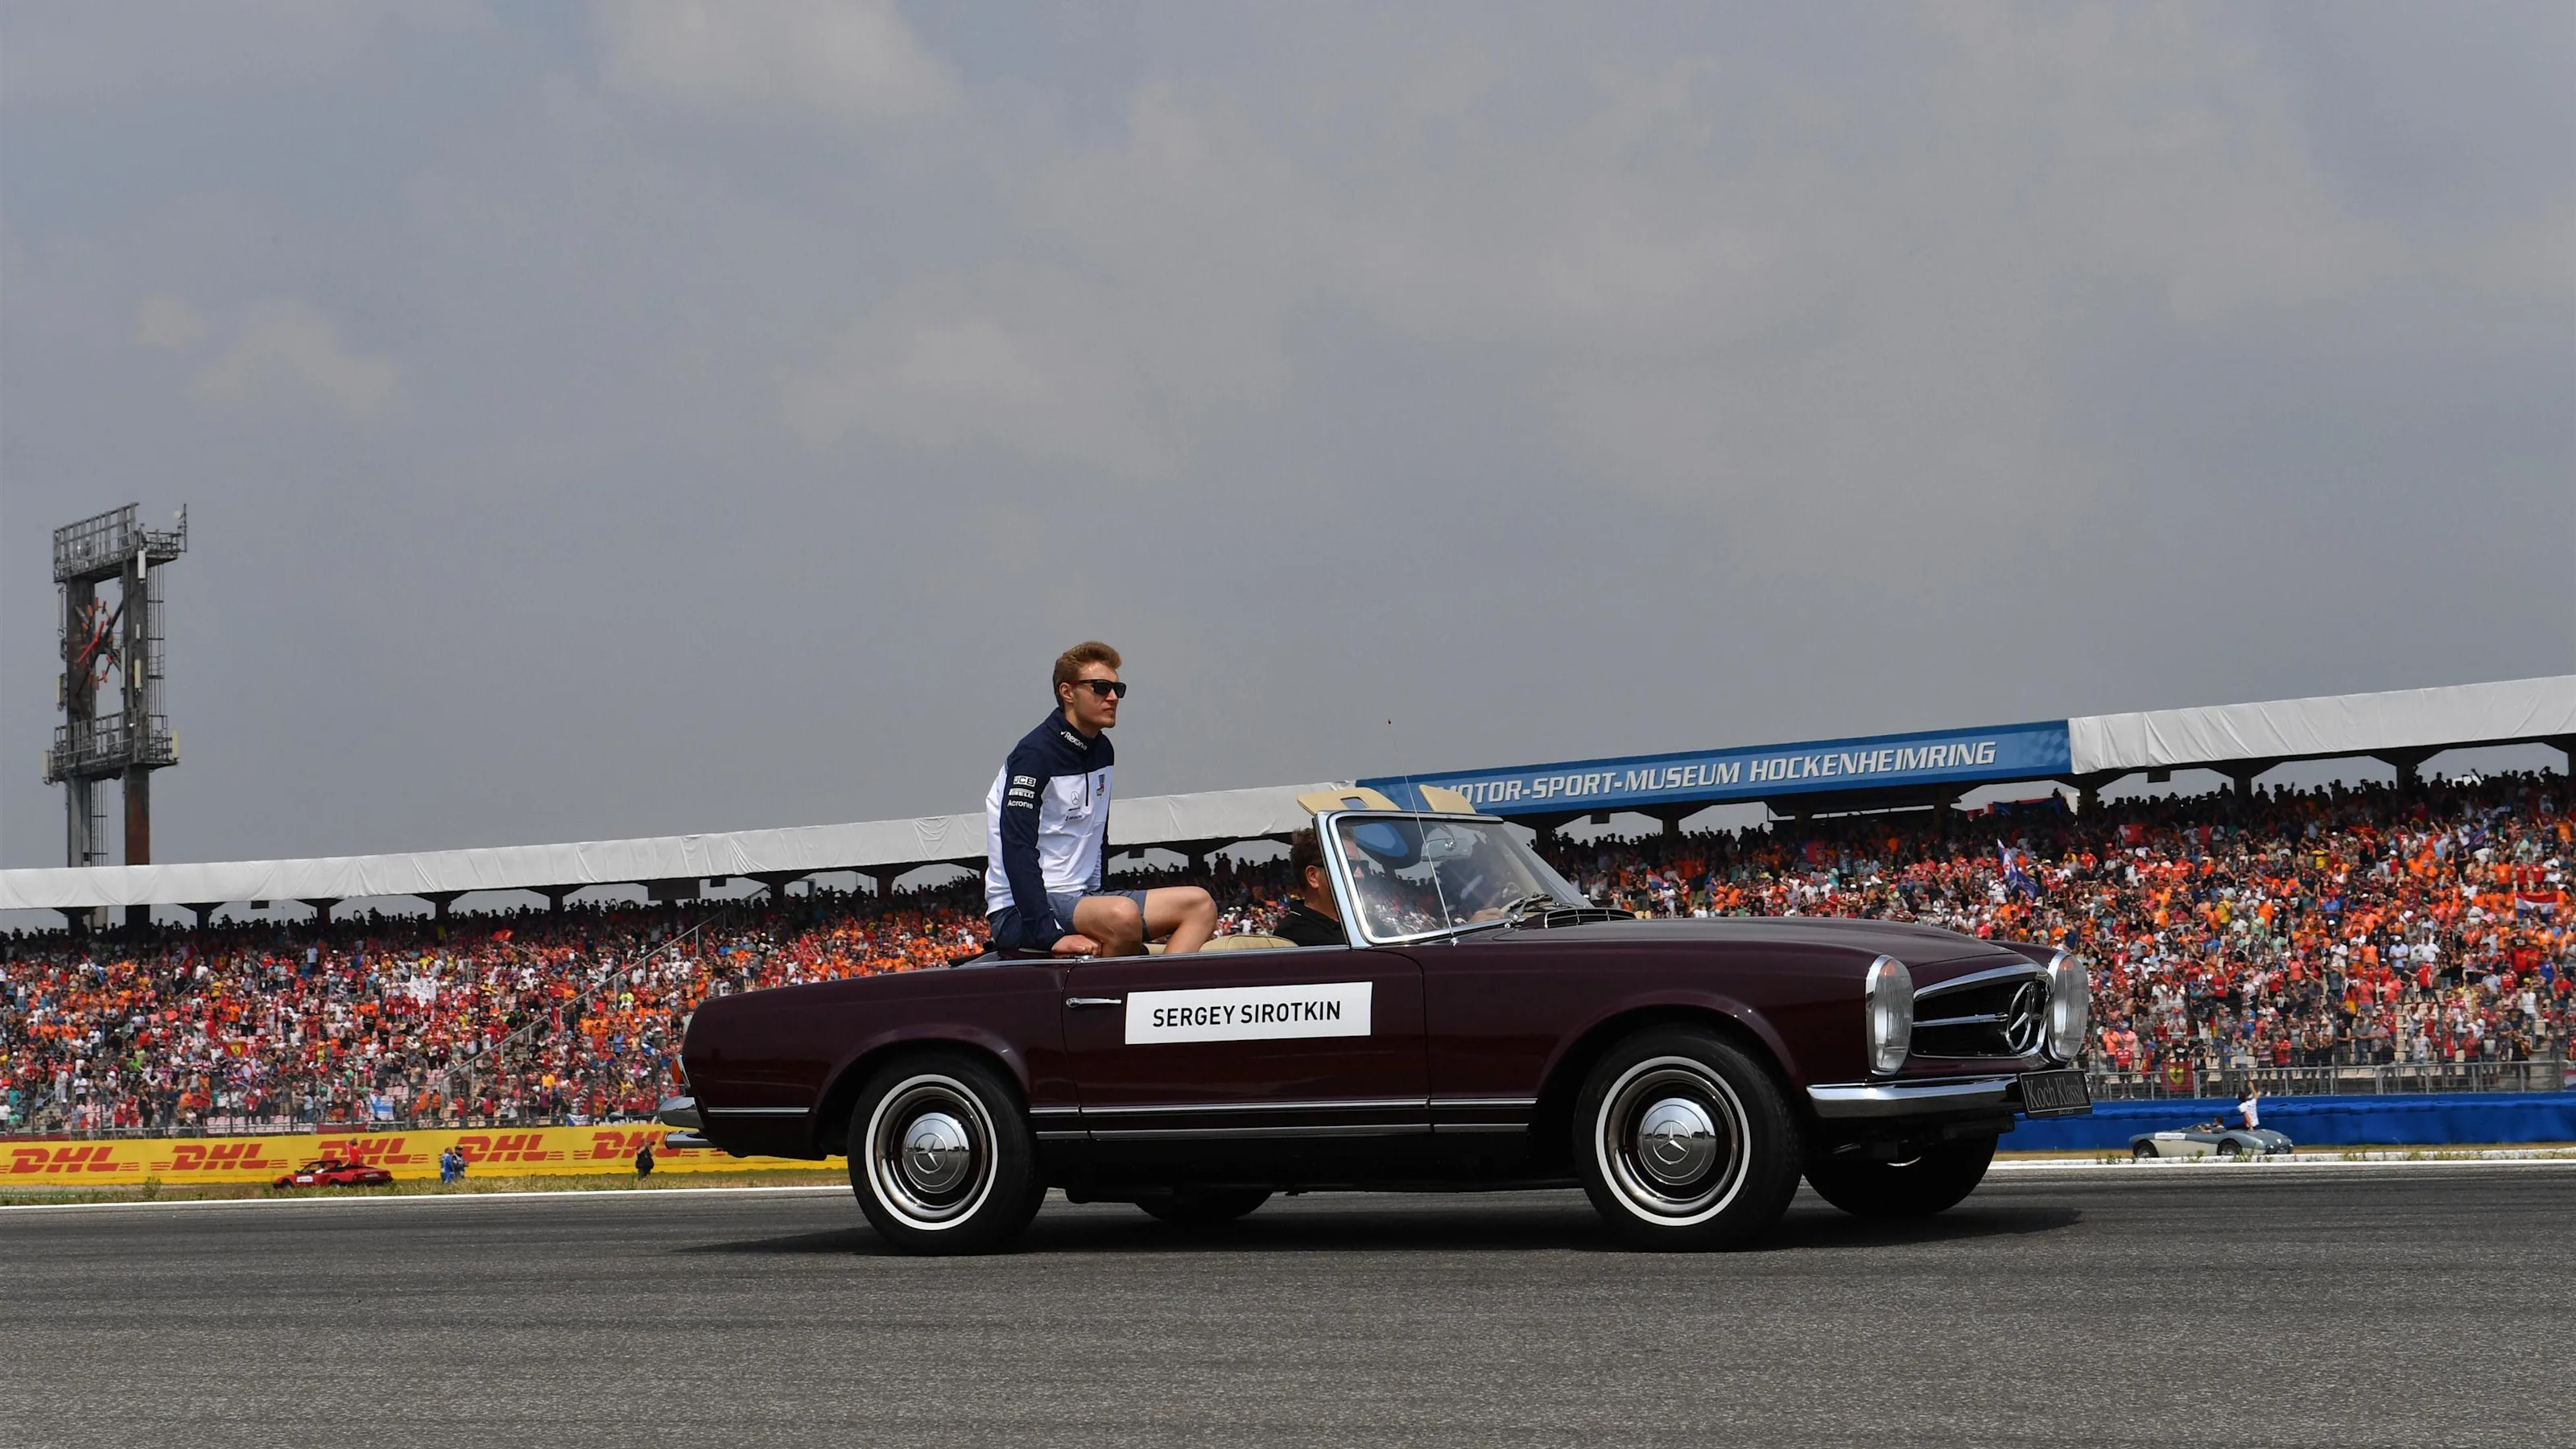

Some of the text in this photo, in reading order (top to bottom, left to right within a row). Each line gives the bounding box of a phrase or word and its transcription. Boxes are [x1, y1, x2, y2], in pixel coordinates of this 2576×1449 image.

[1064, 730, 1088, 751] Rexona
[1013, 776, 1035, 786] JCB
[1439, 741, 1997, 804] OTOR-SPORT-MUSEUM HOCKENHEIMRING
[1007, 799, 1034, 810] Acronis
[1153, 1001, 1341, 1027] SERGEY SIROTKIN
[2025, 1075, 2087, 1108] Koch Klassik
[9, 1146, 119, 1174] DHL
[170, 1143, 269, 1170] DHL
[318, 1137, 411, 1165] DHL
[457, 1133, 548, 1162] DHL
